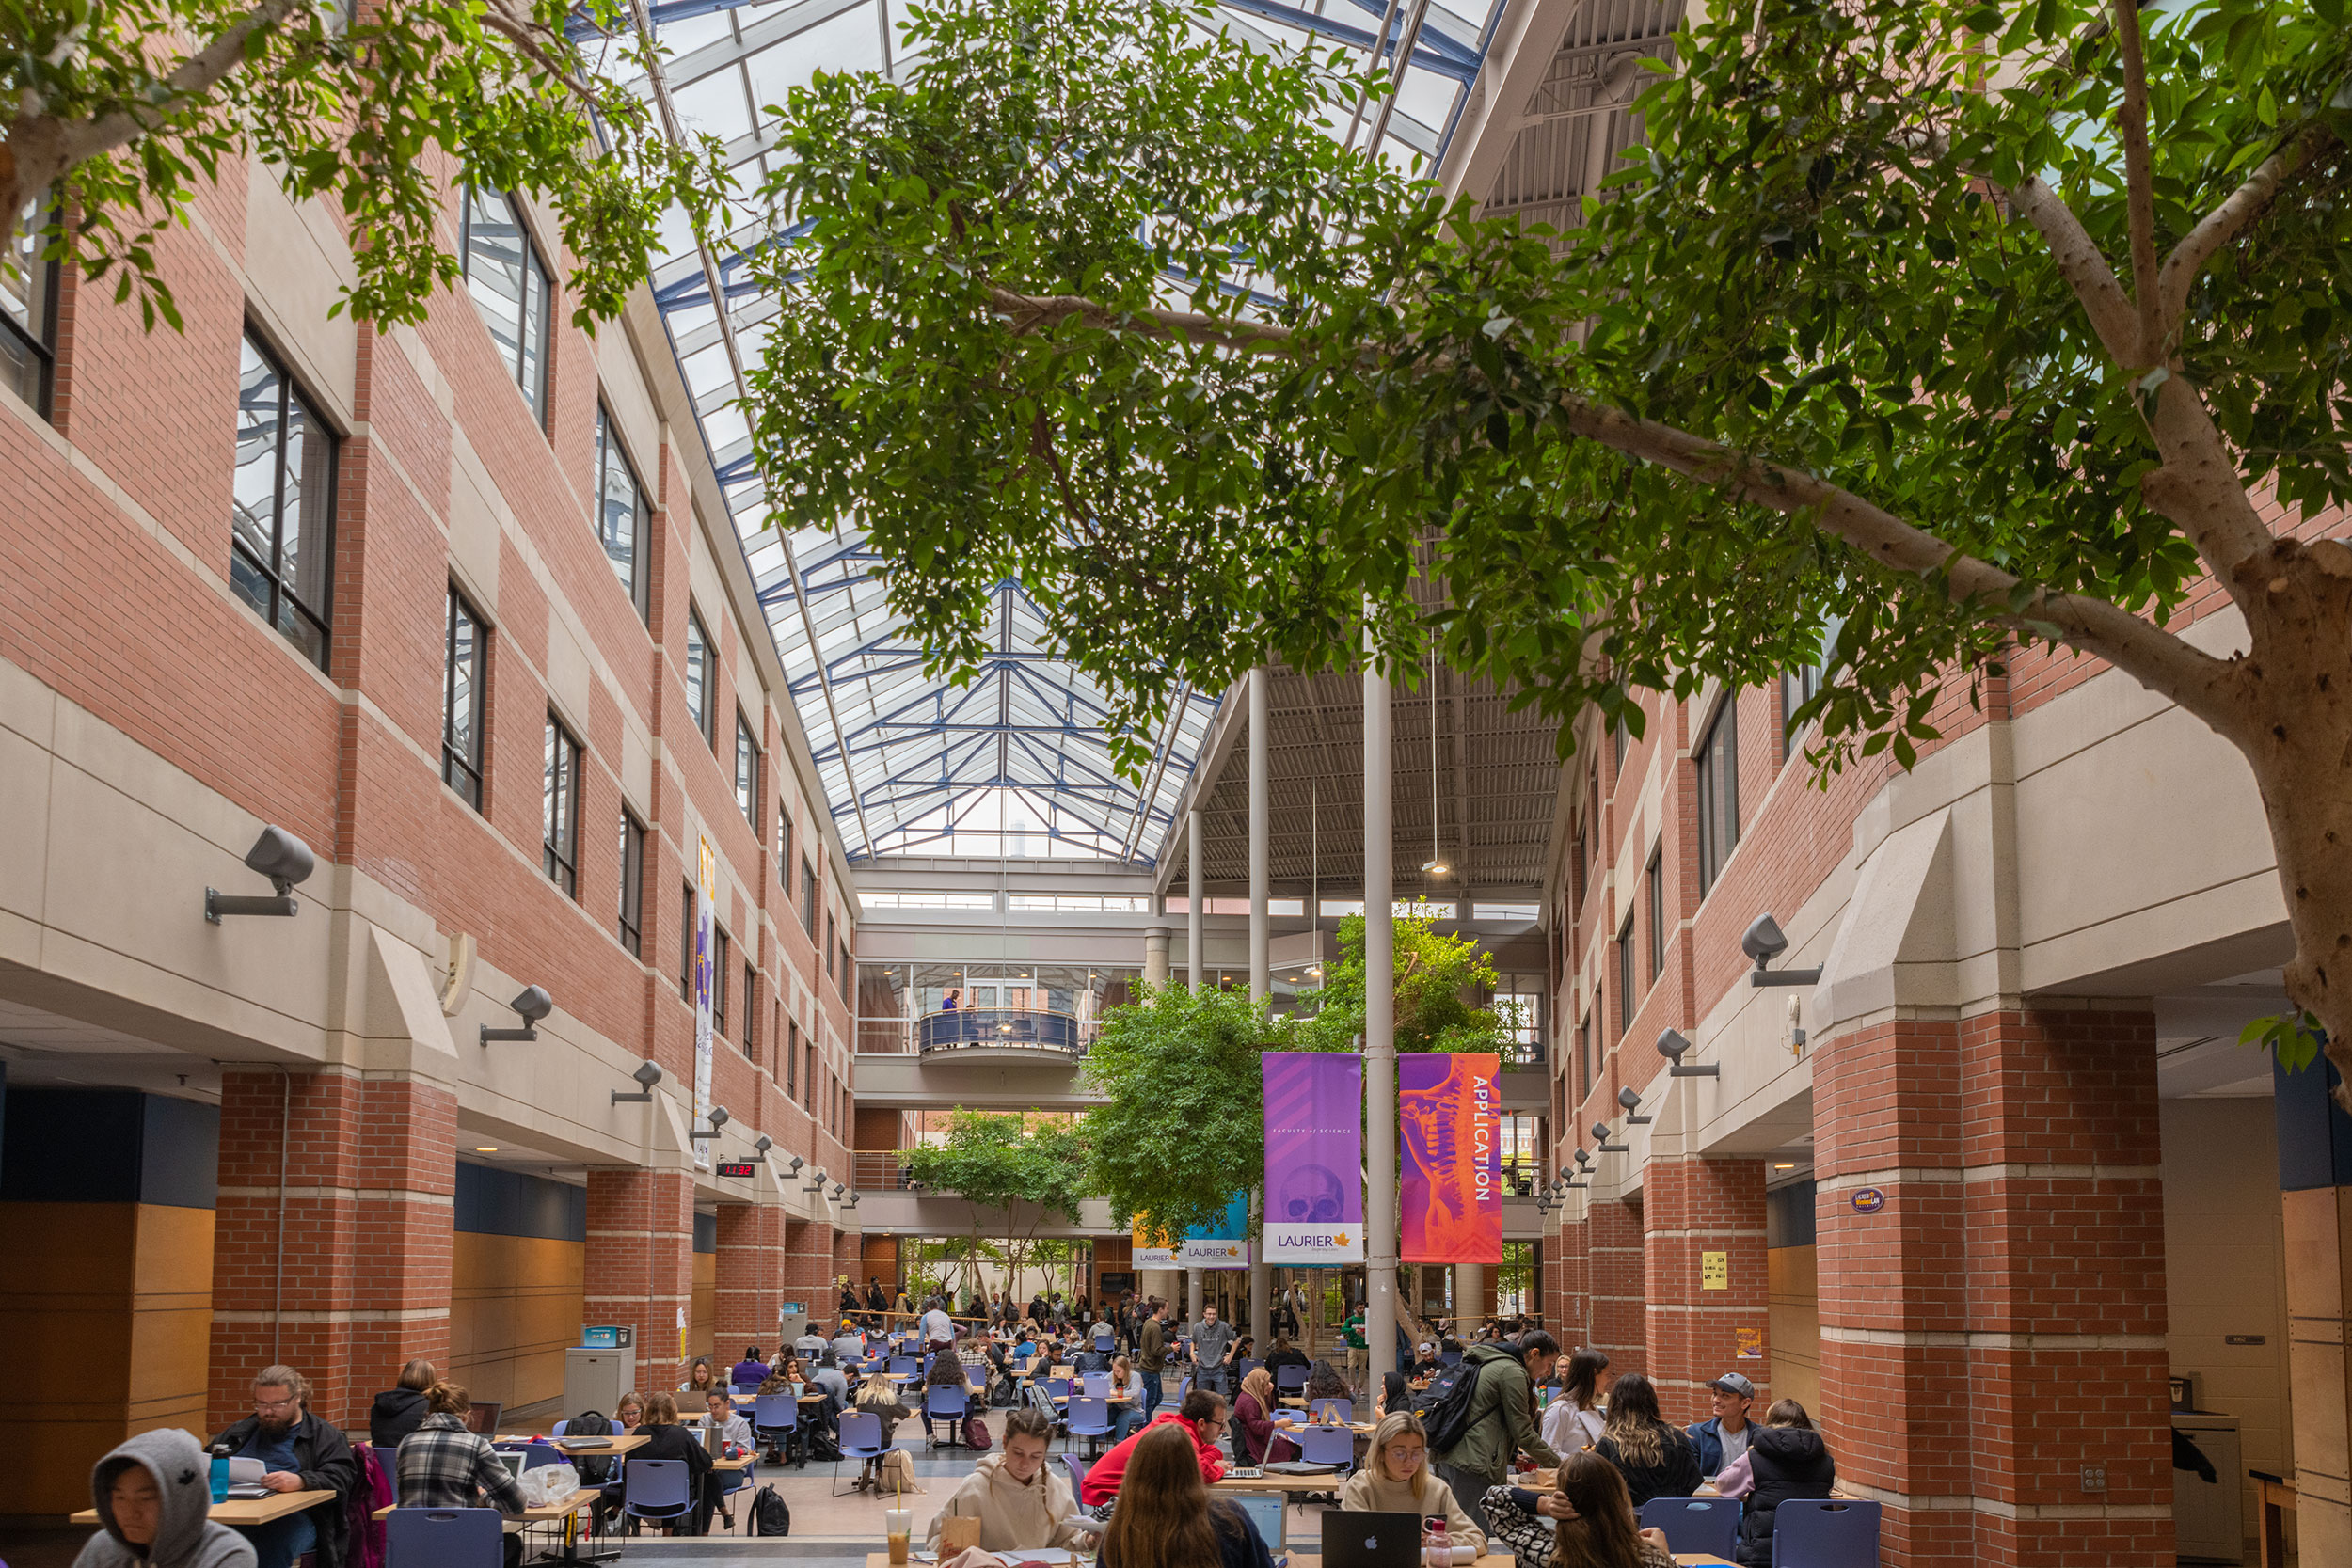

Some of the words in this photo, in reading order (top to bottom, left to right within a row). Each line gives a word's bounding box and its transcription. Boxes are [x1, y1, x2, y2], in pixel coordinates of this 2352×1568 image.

[1473, 1075, 1490, 1200] APPLICATION
[1278, 1235, 1333, 1247] LAURIER
[1188, 1247, 1227, 1257] LAURIER
